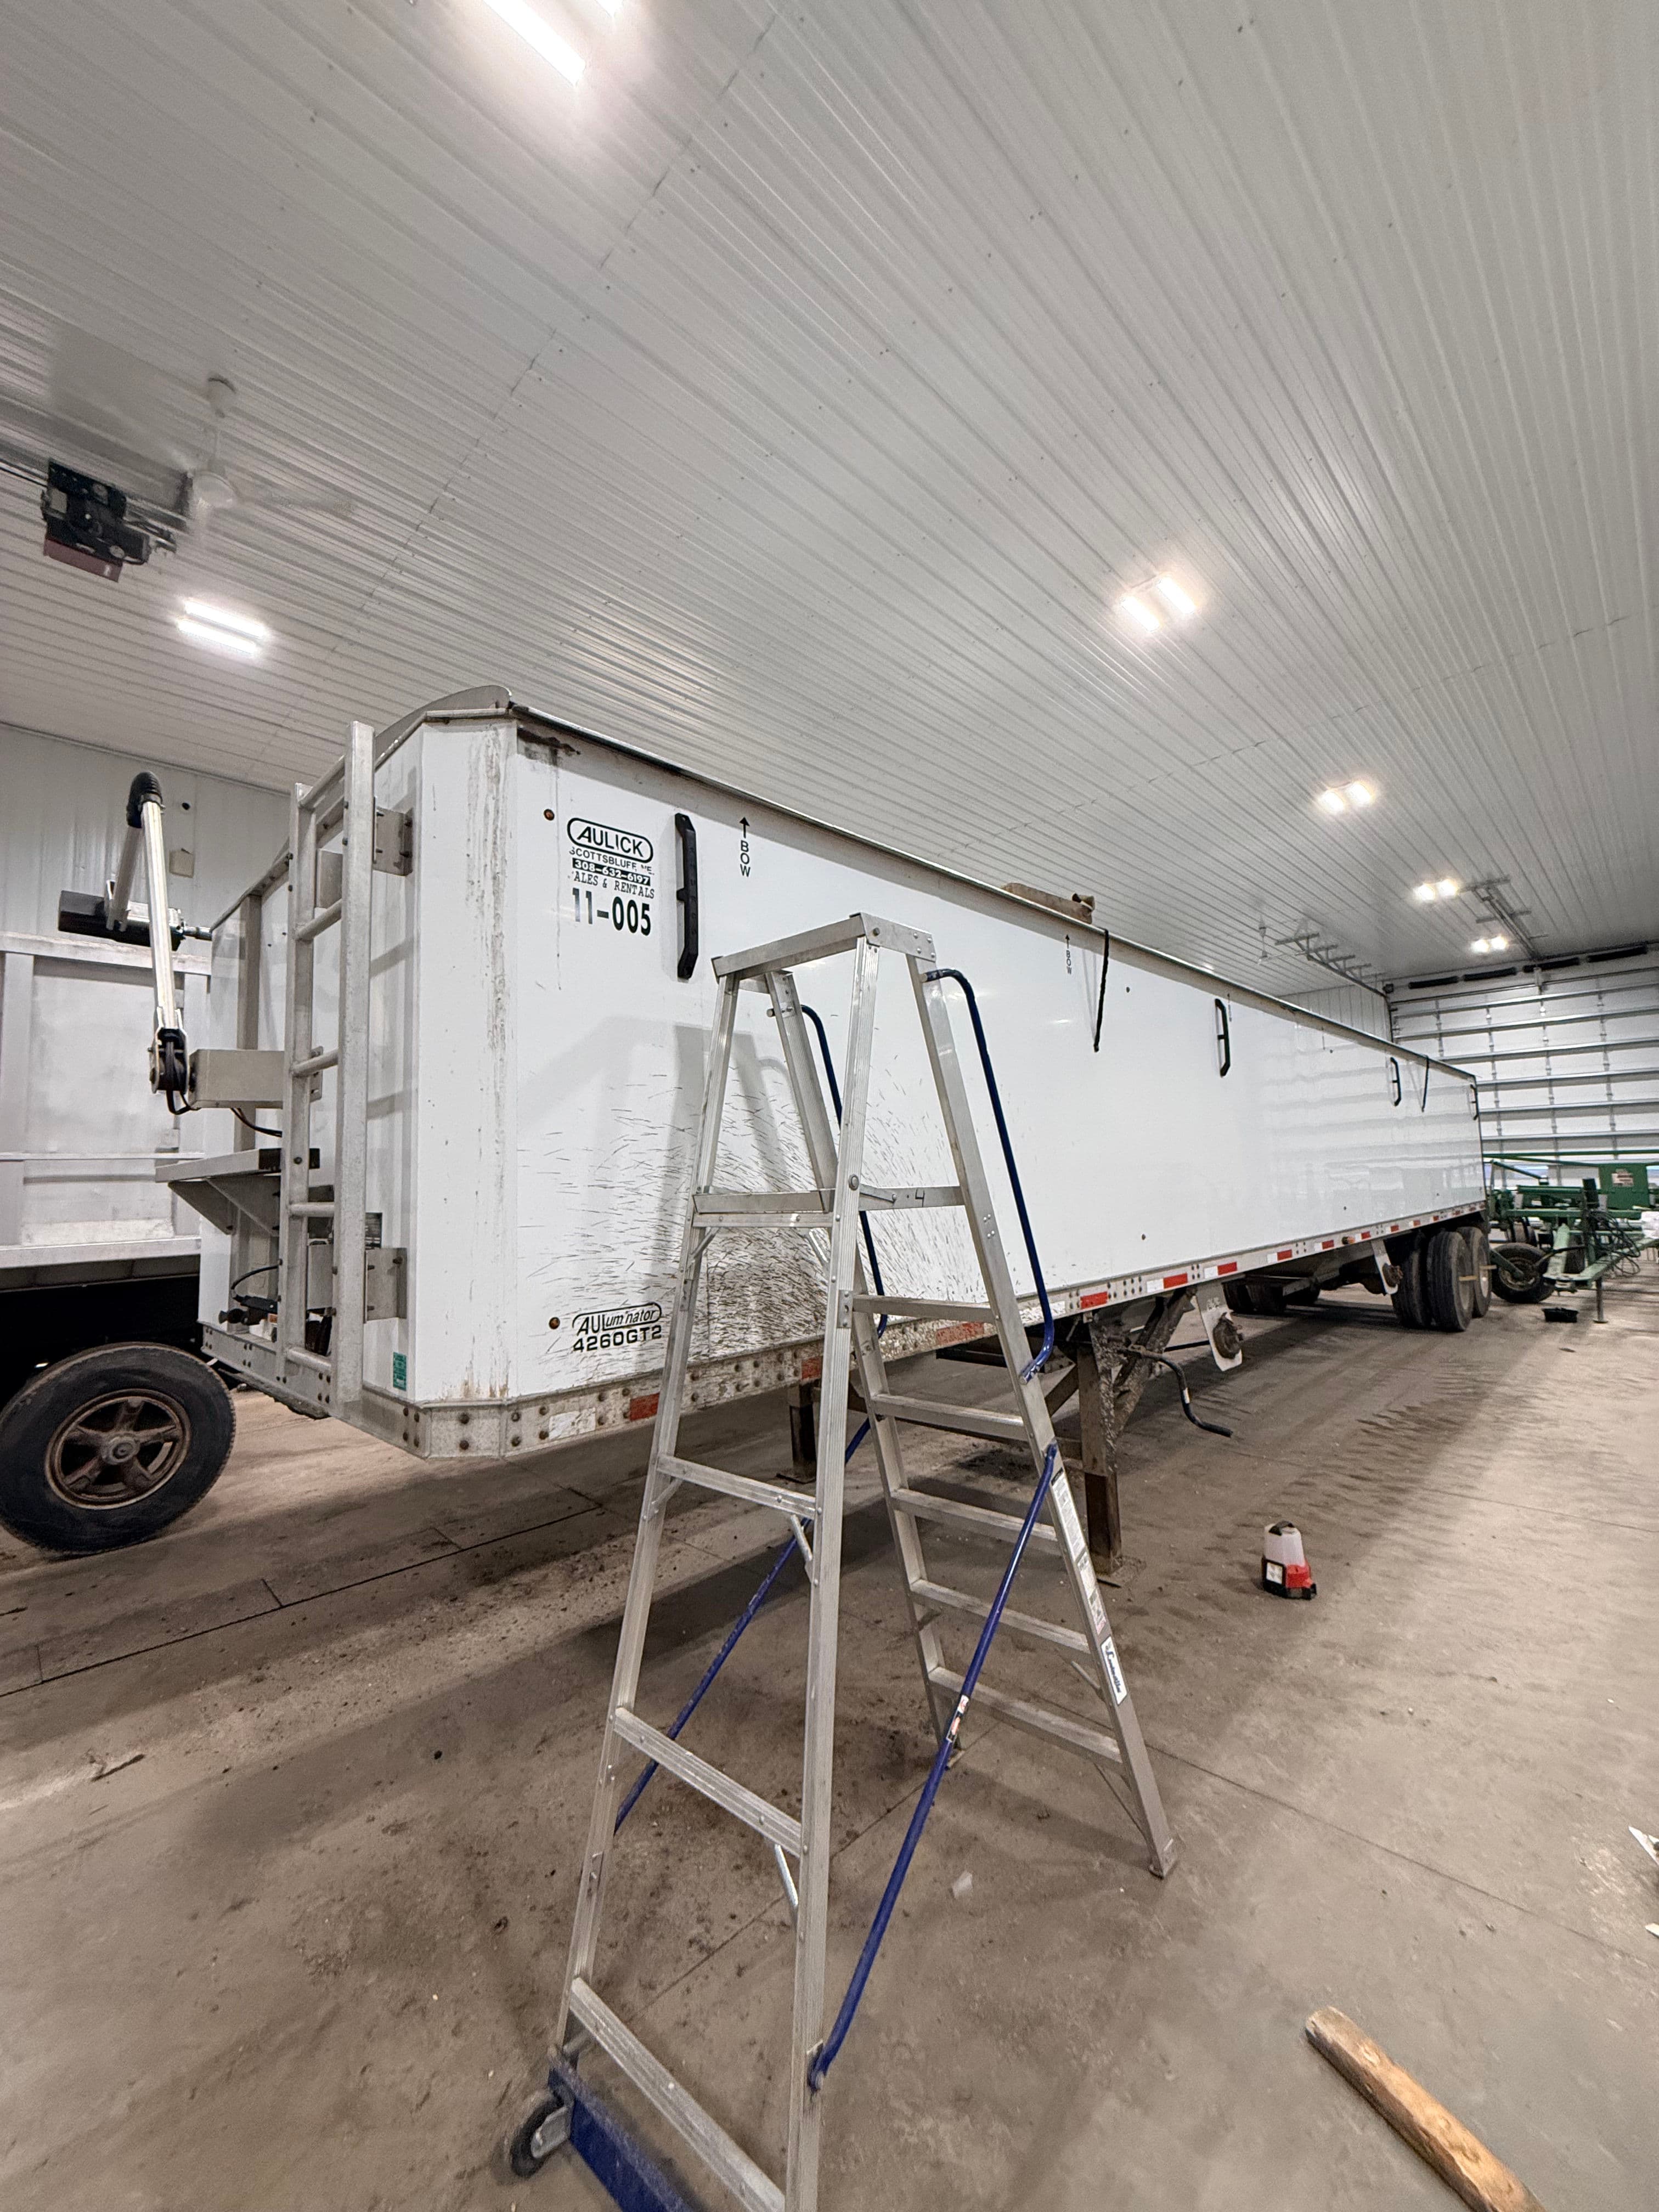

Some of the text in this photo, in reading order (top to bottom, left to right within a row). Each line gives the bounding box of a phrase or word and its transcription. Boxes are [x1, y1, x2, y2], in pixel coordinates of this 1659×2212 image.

[577, 826, 644, 857] AULICK
[574, 859, 650, 884] 308-632-6197
[740, 840, 751, 877] BOW
[602, 878, 608, 889] &
[614, 881, 655, 899] RENTALS
[572, 887, 651, 936] 11-005
[573, 1325, 662, 1353] 4260GT2
